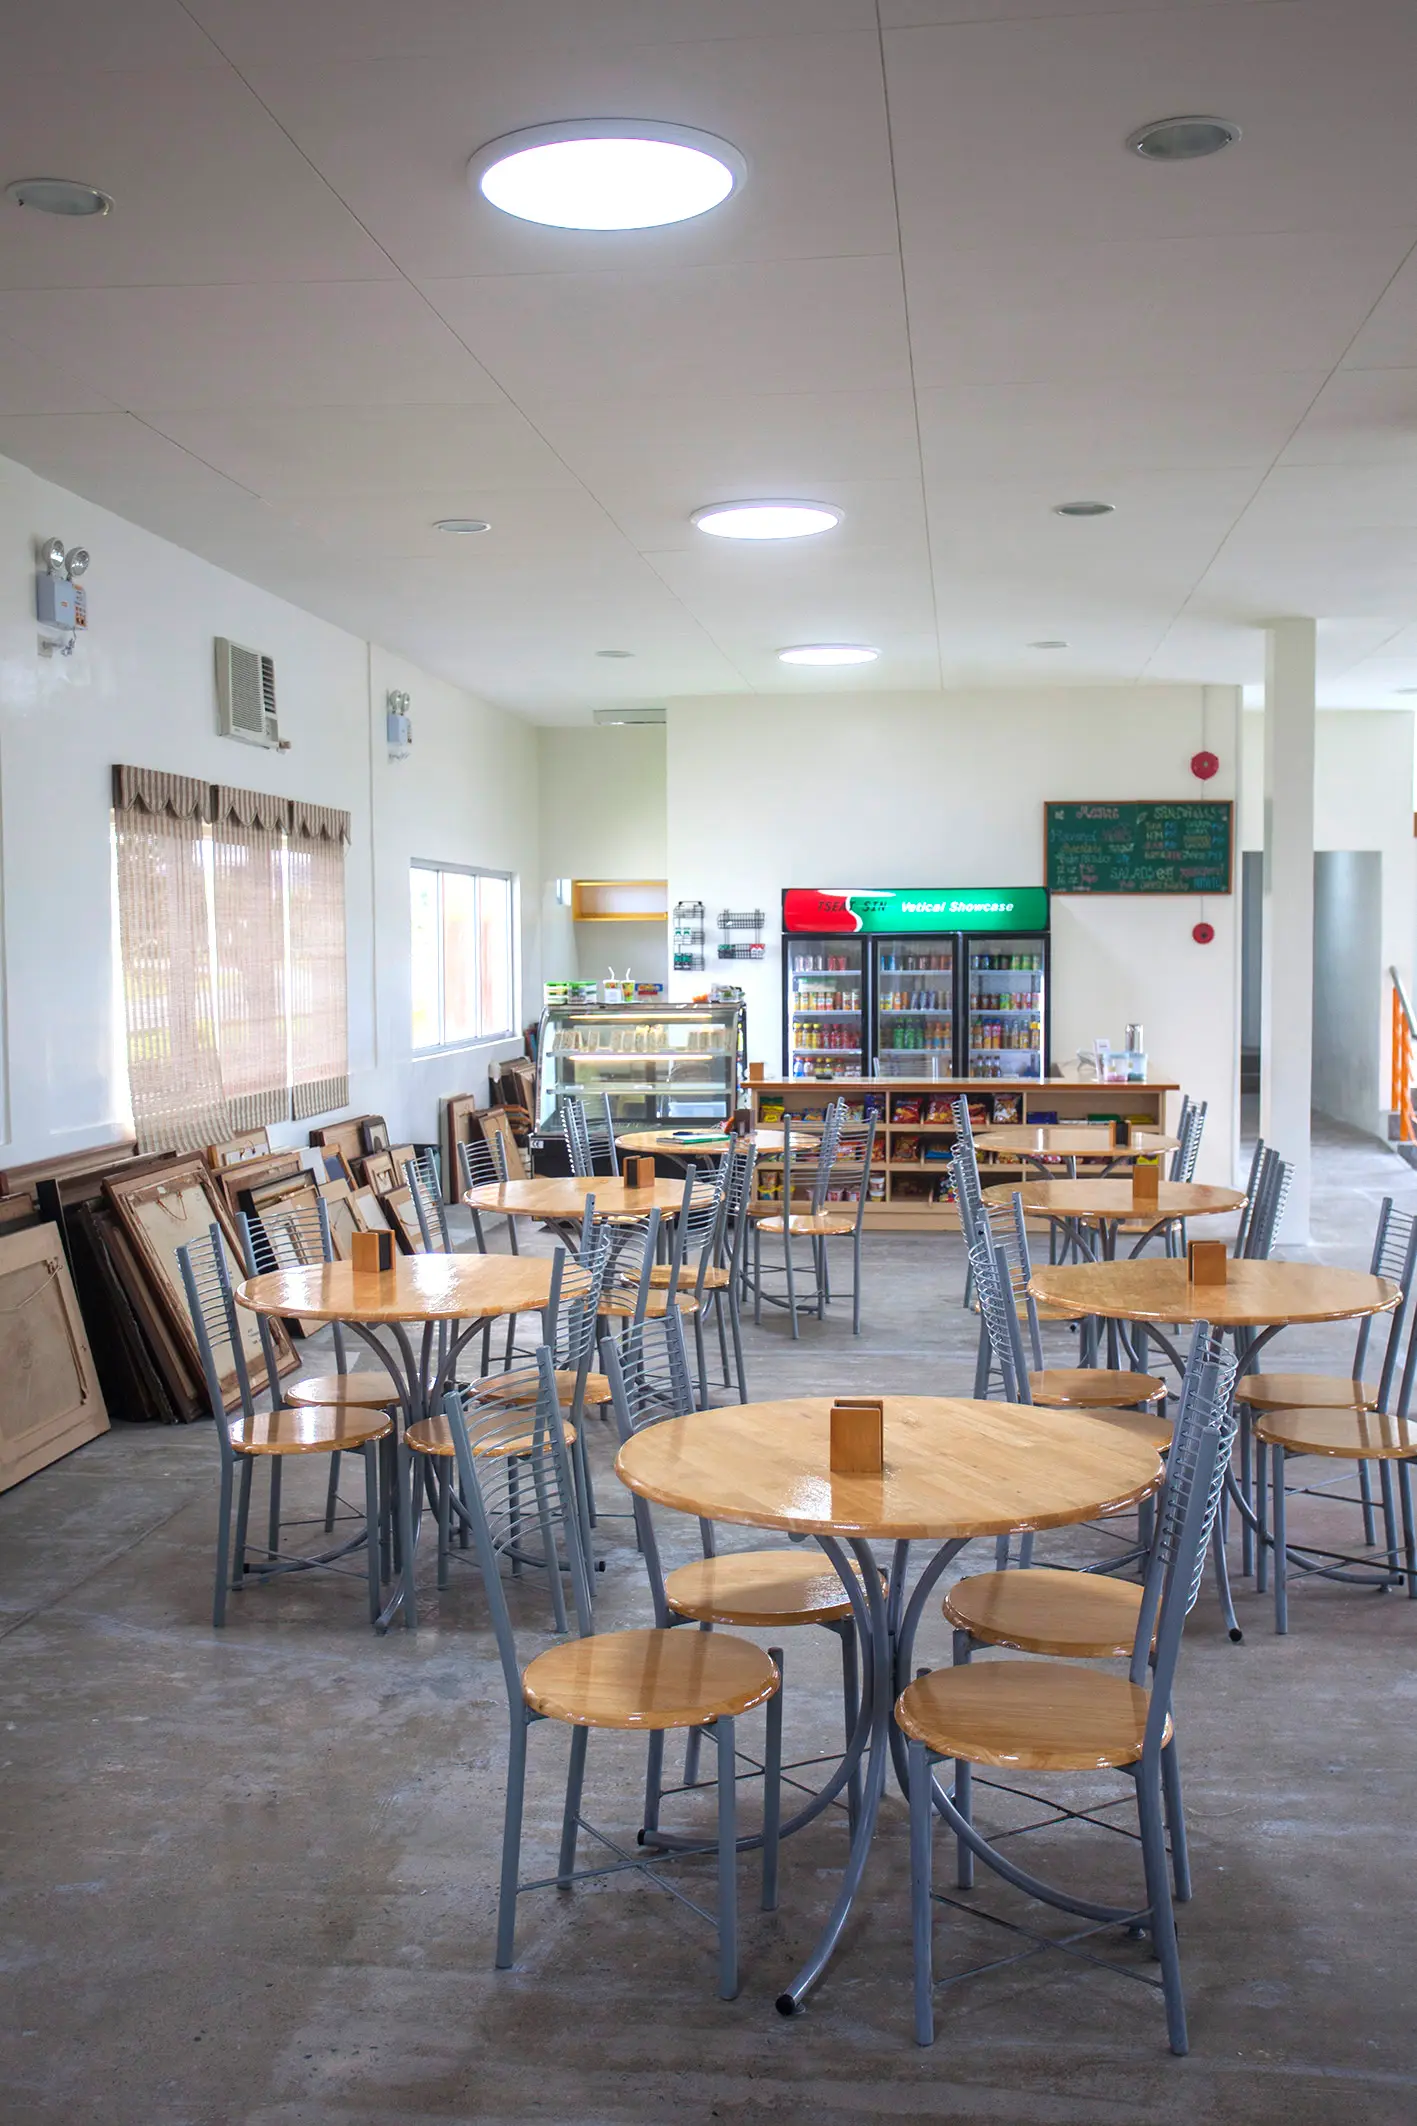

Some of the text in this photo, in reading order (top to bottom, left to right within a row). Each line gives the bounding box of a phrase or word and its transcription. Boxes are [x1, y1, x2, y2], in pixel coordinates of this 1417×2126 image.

[861, 900, 888, 912] SIN
[901, 901, 1014, 913] Vetical Showcase
